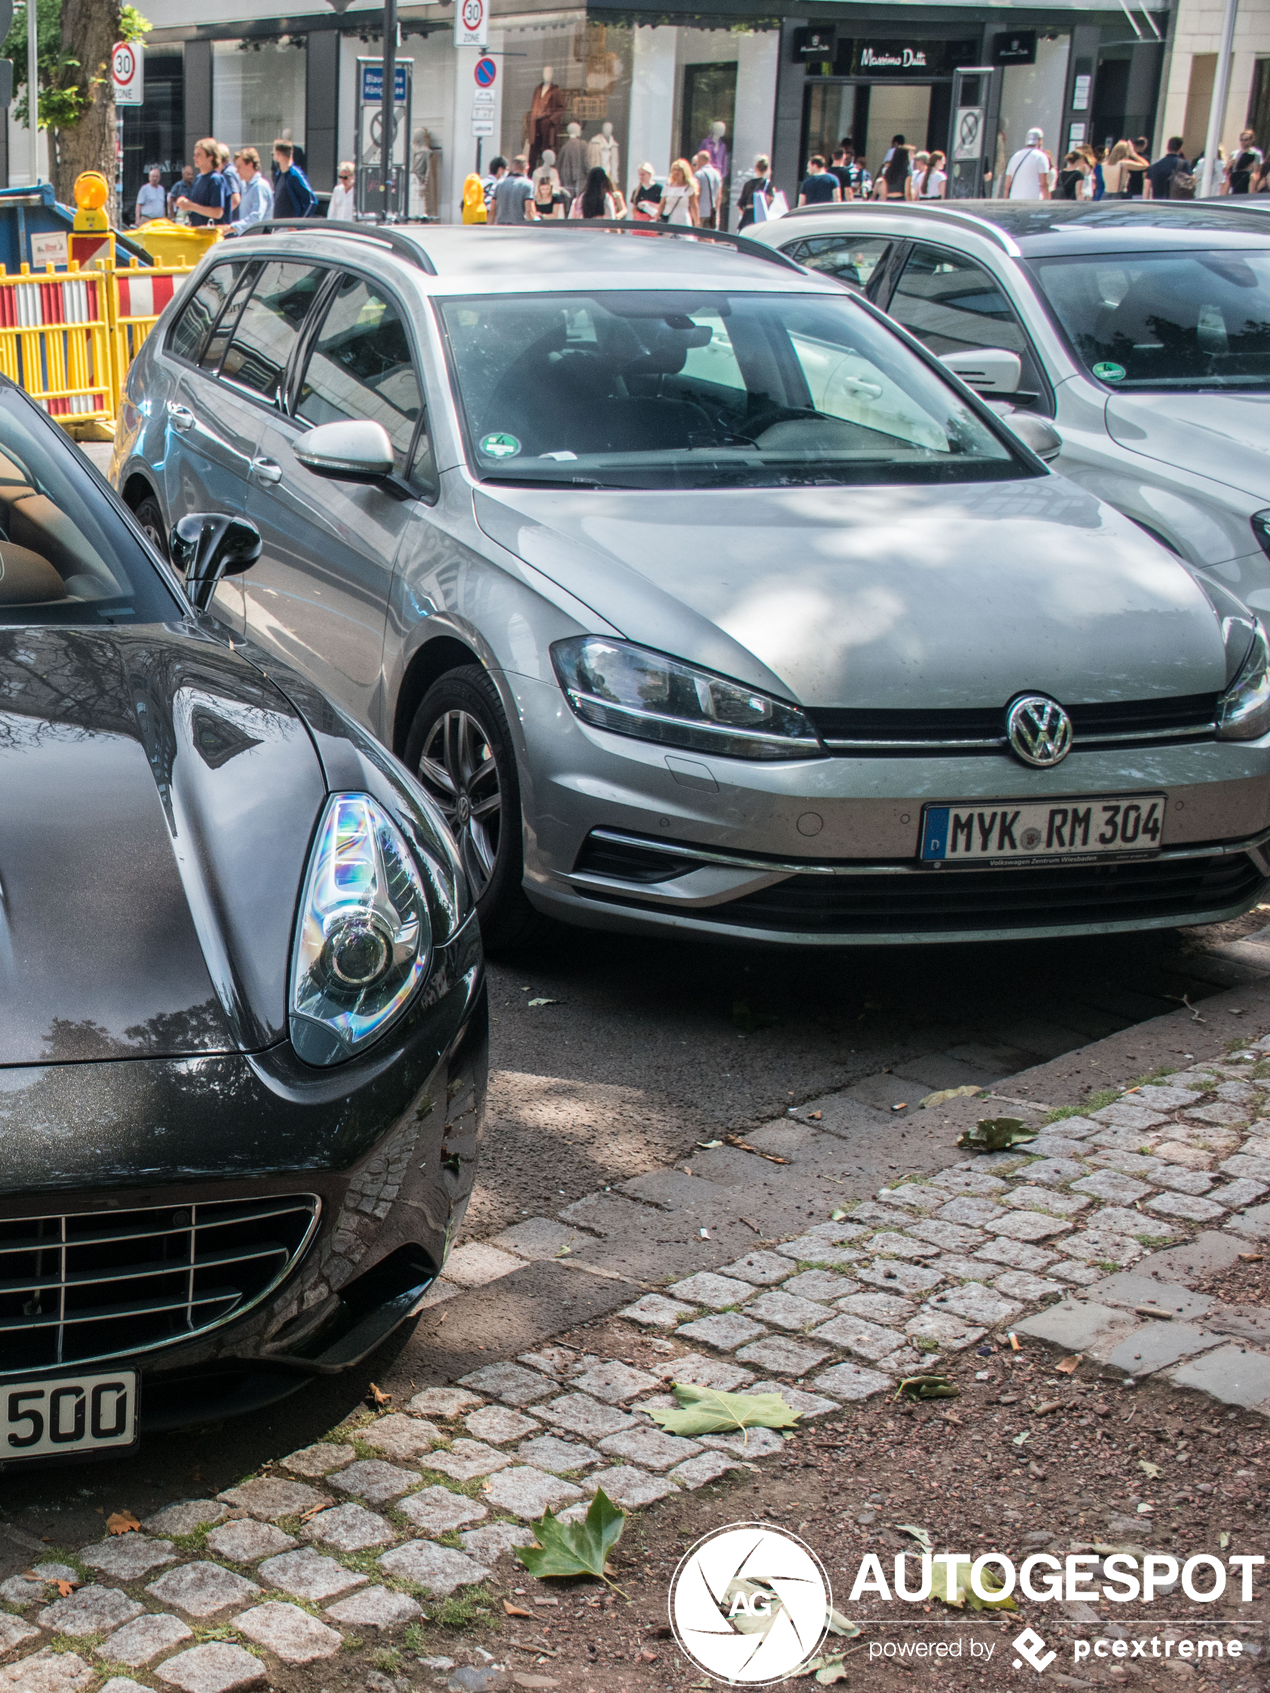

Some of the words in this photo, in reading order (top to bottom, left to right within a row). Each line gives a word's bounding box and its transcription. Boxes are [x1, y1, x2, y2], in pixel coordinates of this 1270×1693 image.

[466, 4, 479, 21] 30
[116, 54, 131, 74] 30
[860, 47, 902, 67] Massimo
[902, 47, 927, 68] Dutti
[950, 810, 1021, 852] MYK
[1046, 807, 1092, 849] RM
[1099, 803, 1160, 845] 304
[931, 839, 940, 851] D
[989, 858, 1030, 867] Volkswagen
[1031, 857, 1060, 865] Zentrum
[1061, 855, 1097, 863] Wiesbaden
[8, 1382, 127, 1448] 500
